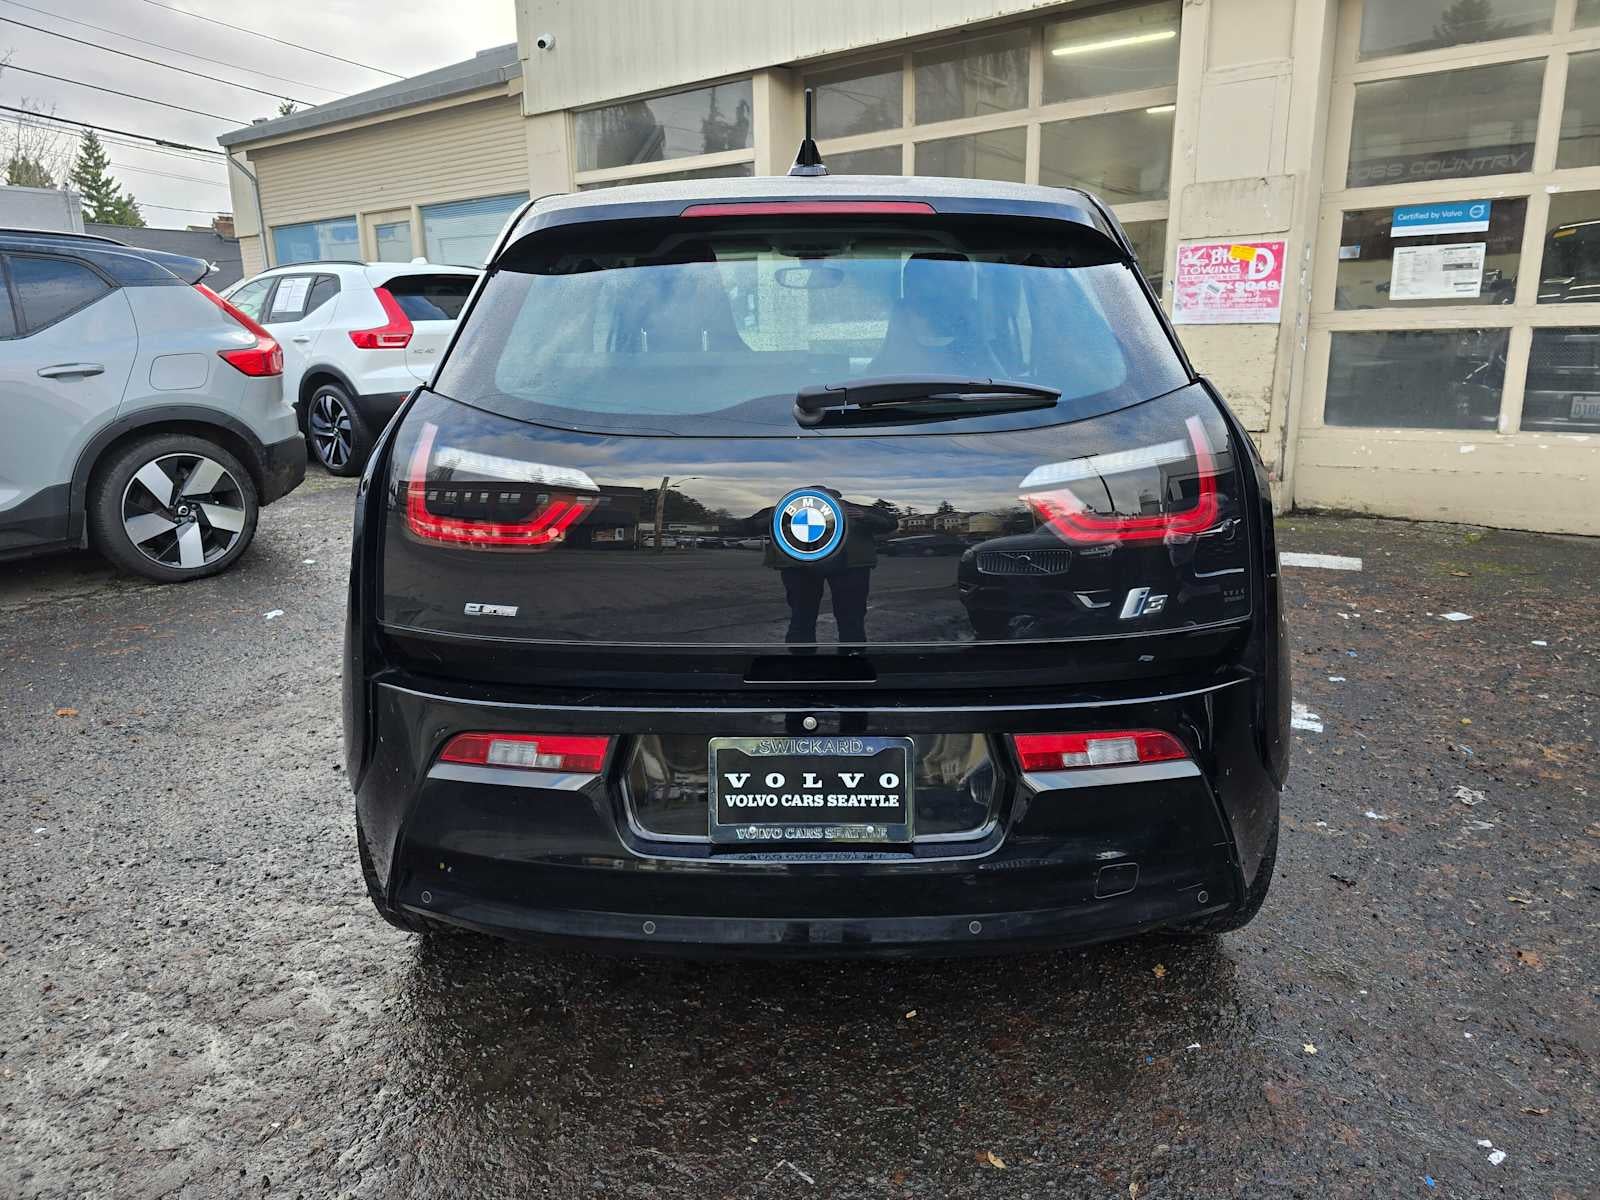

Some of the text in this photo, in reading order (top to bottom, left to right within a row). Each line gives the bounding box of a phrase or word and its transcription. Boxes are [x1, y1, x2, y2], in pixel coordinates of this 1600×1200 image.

[1409, 151, 1528, 175] COUNTRY
[1398, 211, 1429, 221] Certified
[1431, 210, 1440, 219] by
[1442, 209, 1463, 218] Volvo
[1182, 264, 1241, 275] TOWING
[785, 498, 832, 517] BMW
[759, 739, 863, 754] SWICKARD
[724, 772, 900, 788] VOLVO
[725, 794, 900, 807] VOLVO CARS SEATTLE
[735, 828, 783, 840] VOLVO
[785, 828, 823, 839] CARS
